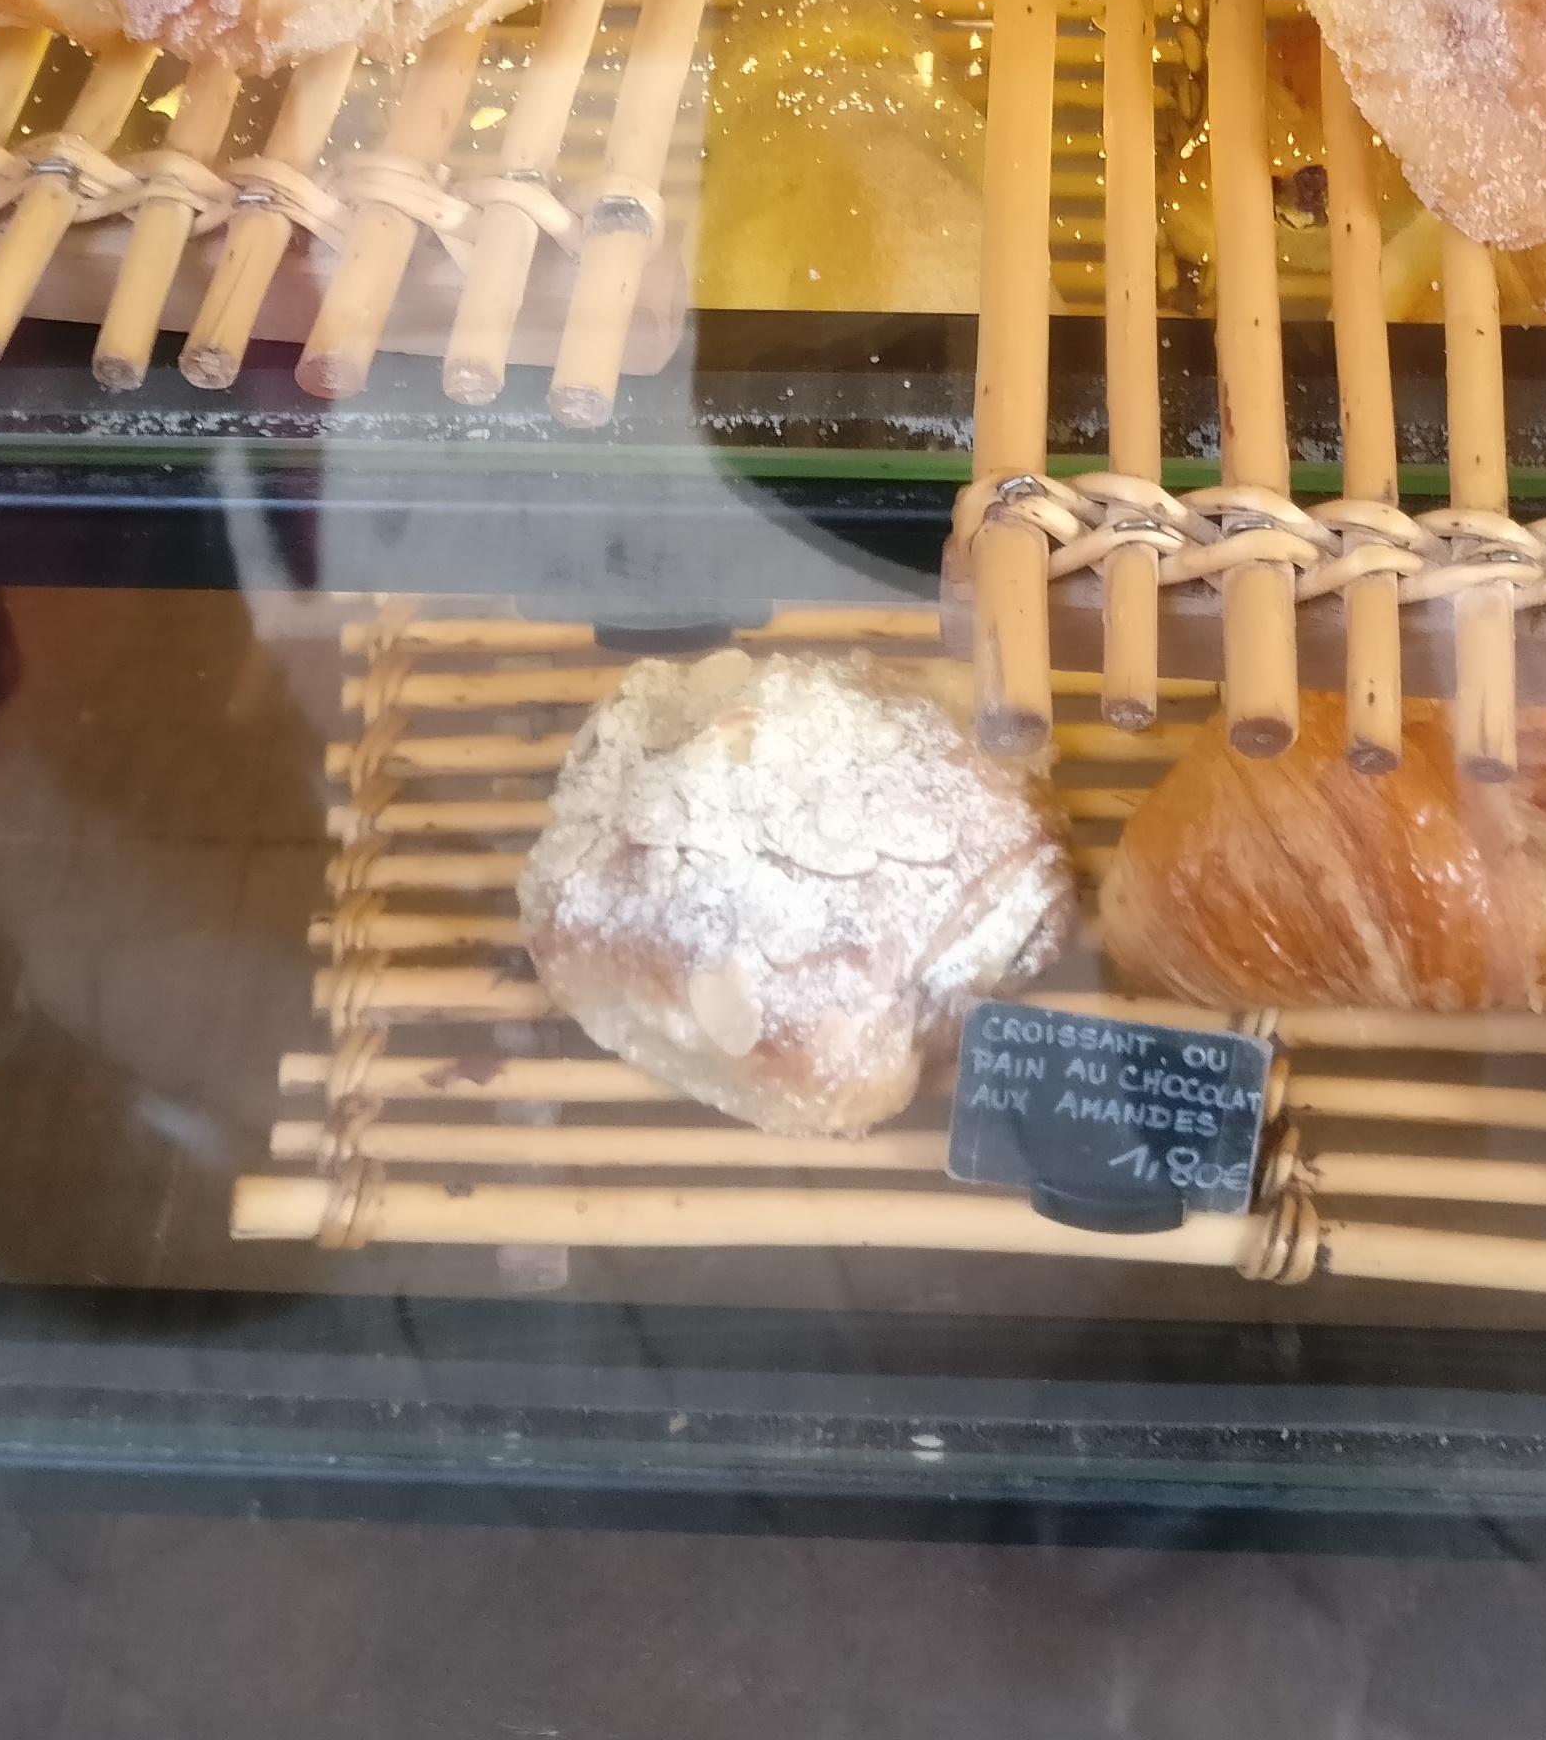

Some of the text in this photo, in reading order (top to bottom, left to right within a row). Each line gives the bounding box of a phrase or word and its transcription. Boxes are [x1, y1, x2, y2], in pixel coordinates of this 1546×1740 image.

[970, 1047, 1262, 1114] PAIN AU CHOCOLAT
[1183, 1044, 1226, 1072] OU
[969, 1084, 1219, 1137] AUX AMANDES
